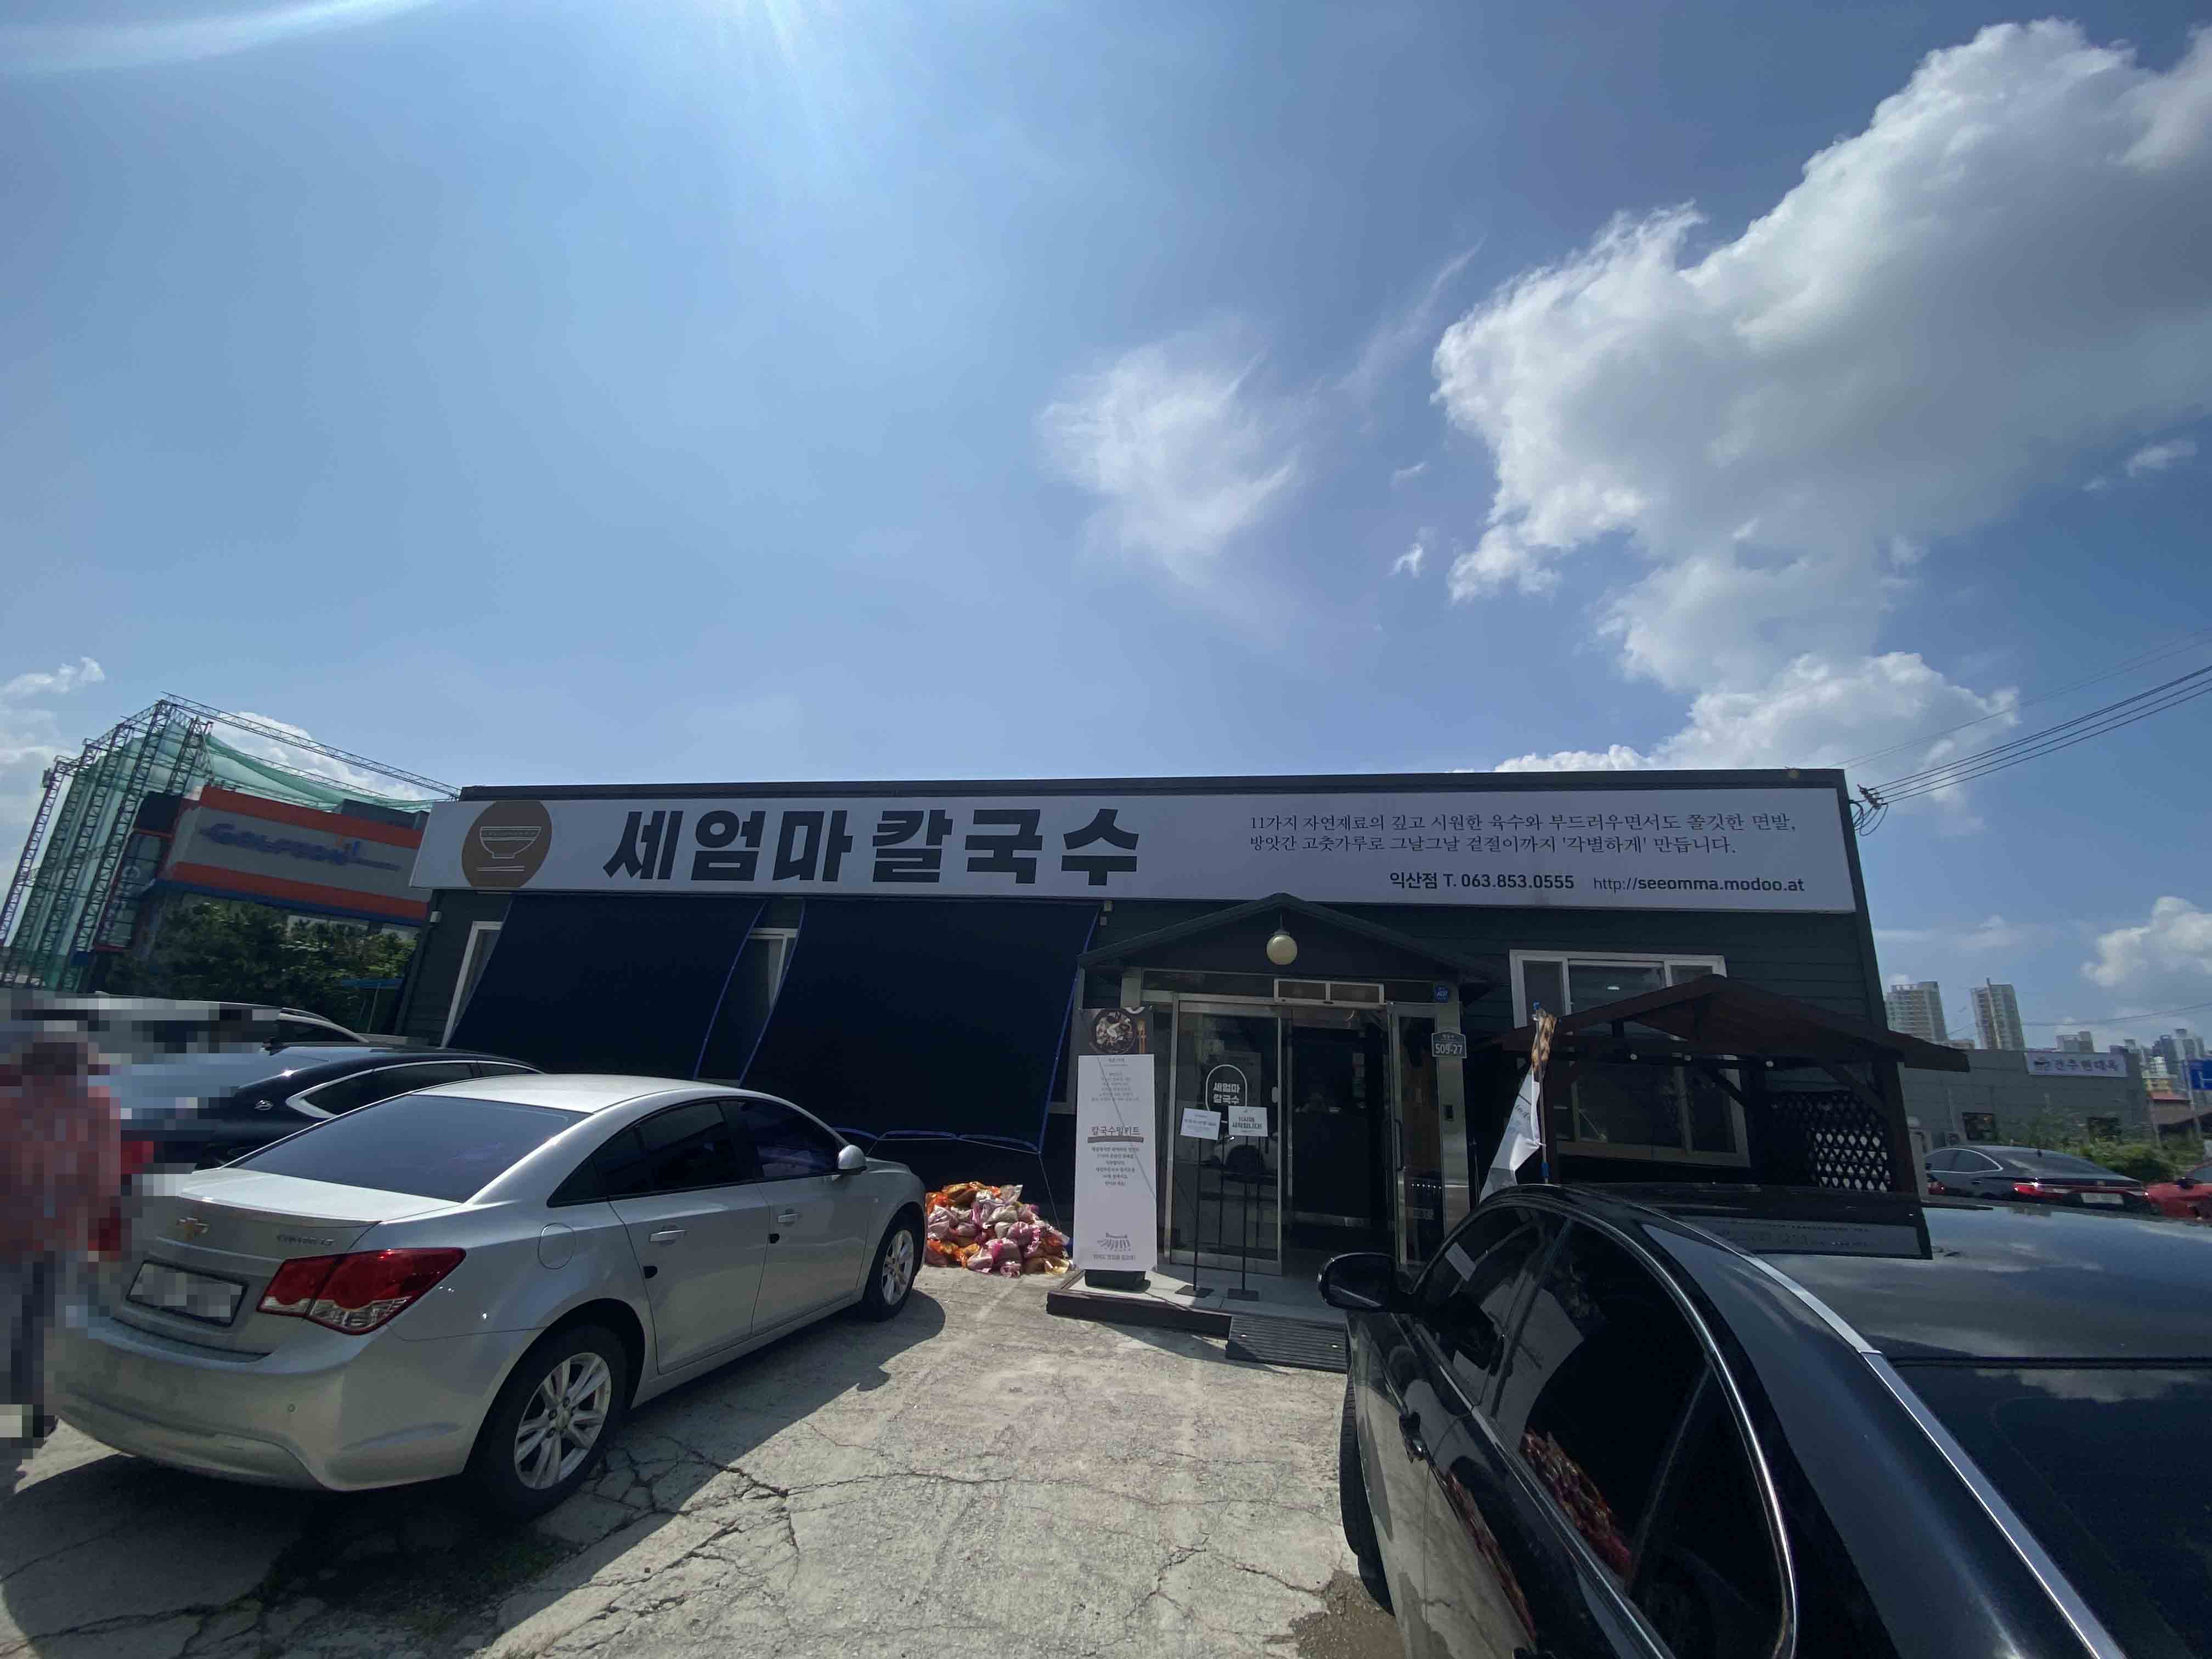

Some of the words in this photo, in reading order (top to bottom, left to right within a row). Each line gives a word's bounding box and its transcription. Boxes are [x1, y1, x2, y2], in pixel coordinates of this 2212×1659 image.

[1250, 815, 1297, 831] 11가지
[1302, 815, 1385, 831] 자연재료의
[1391, 815, 1426, 831] 깊고
[1431, 814, 1483, 831] 시원한
[1488, 814, 1543, 831] 육수와
[1549, 814, 1681, 831] 부드러우면서도
[1686, 813, 1745, 832] 쫄깃한
[1751, 813, 1796, 832] 면발,
[603, 808, 1138, 887] 세엄마칼국수
[1250, 836, 1297, 851] 방앗간
[1302, 836, 1386, 852] 고춧가루로
[1390, 836, 1460, 852] 그날그날
[1466, 836, 1557, 853] 겉절이까지
[1654, 836, 1737, 854] 만듭니다.
[1389, 872, 1437, 889] 익산점
[1461, 873, 1575, 889] 063.853.0555
[1593, 877, 1805, 894] http://seeomma.modoo.at
